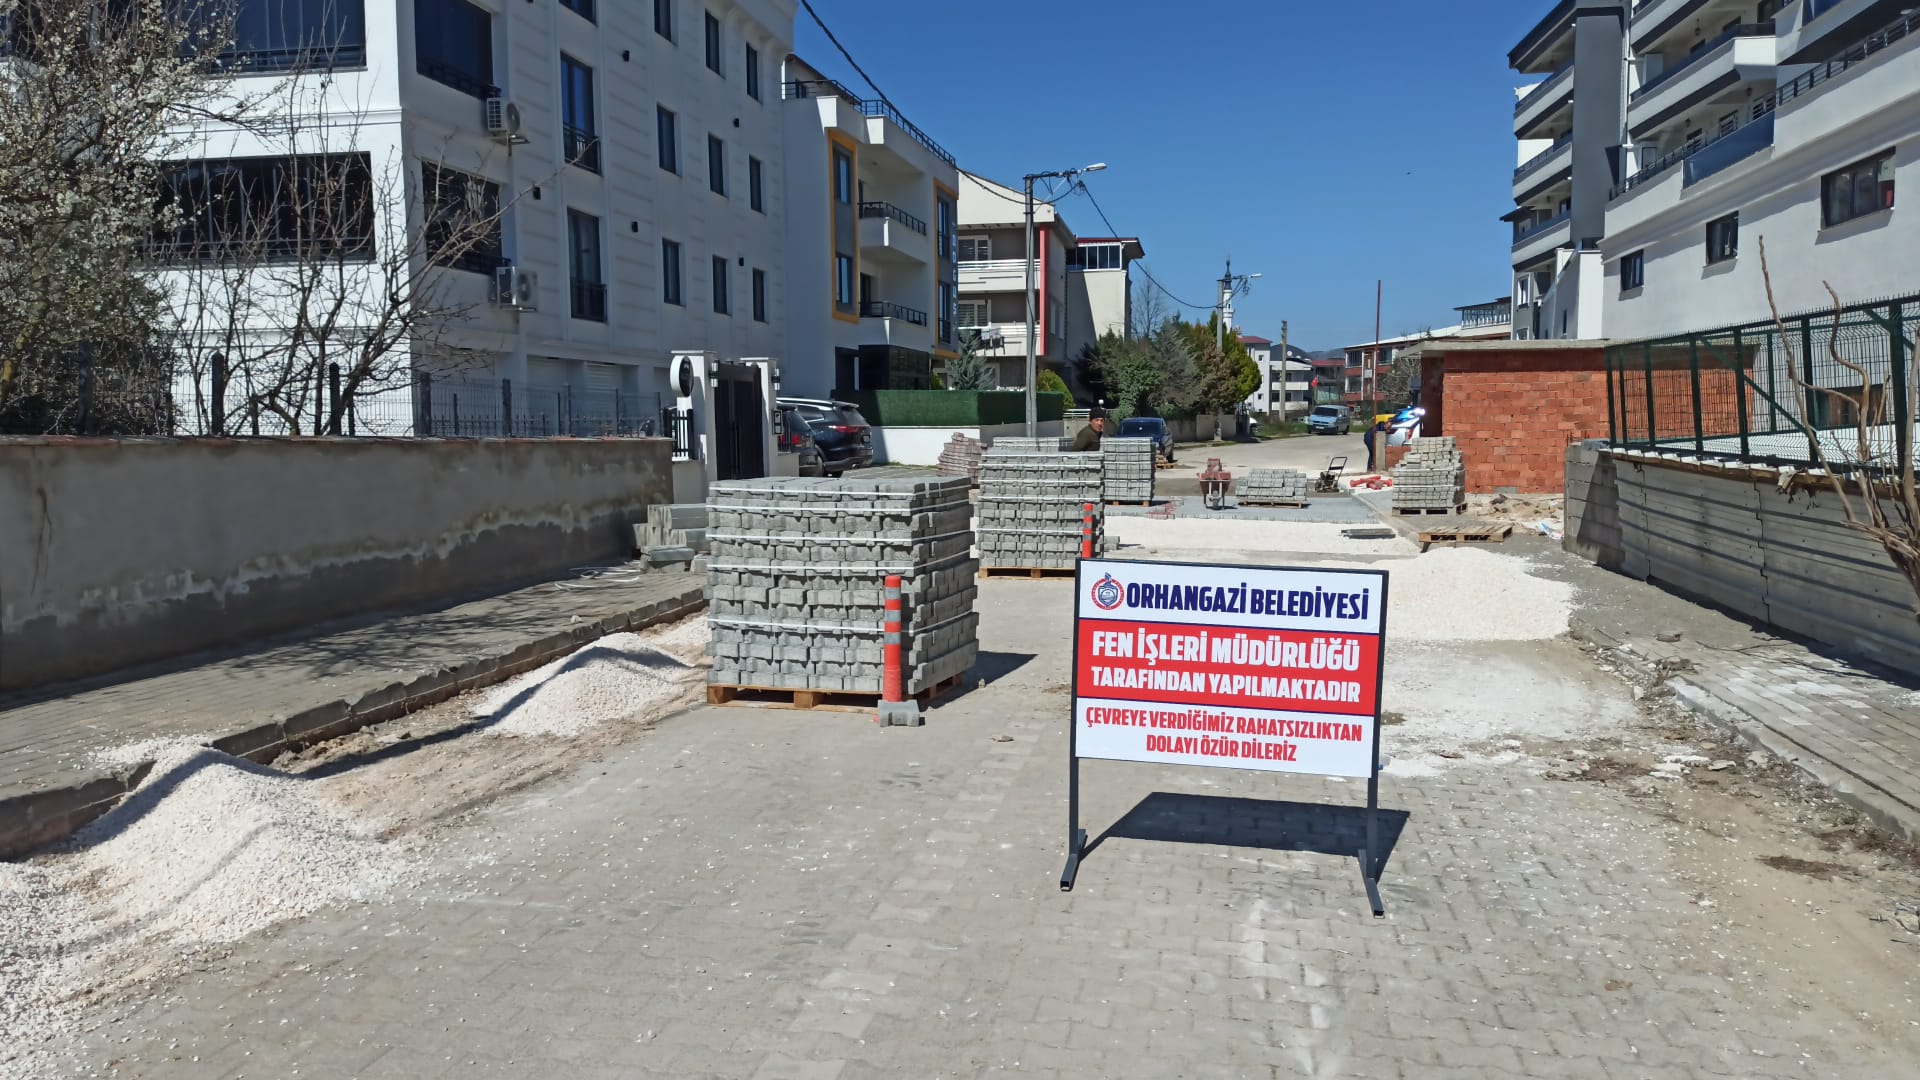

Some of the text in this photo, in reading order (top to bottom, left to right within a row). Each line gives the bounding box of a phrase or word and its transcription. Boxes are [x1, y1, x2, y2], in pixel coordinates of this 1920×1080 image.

[1126, 582, 1247, 613] ORHANGAZİ
[1250, 586, 1369, 620] BELEDİYESİ
[1092, 627, 1361, 671] FEN İŞLERİ MÜDÜRLÜĞÜ
[1091, 666, 1360, 703] TARAFINDAN YAPILMAKTADIR
[1086, 707, 1363, 742] ÇEVREYE VERDİĞİMİZ RAHATSIZLIKTAN
[1146, 734, 1297, 762] DOLAYI ÖZÜR DİLERİZ
